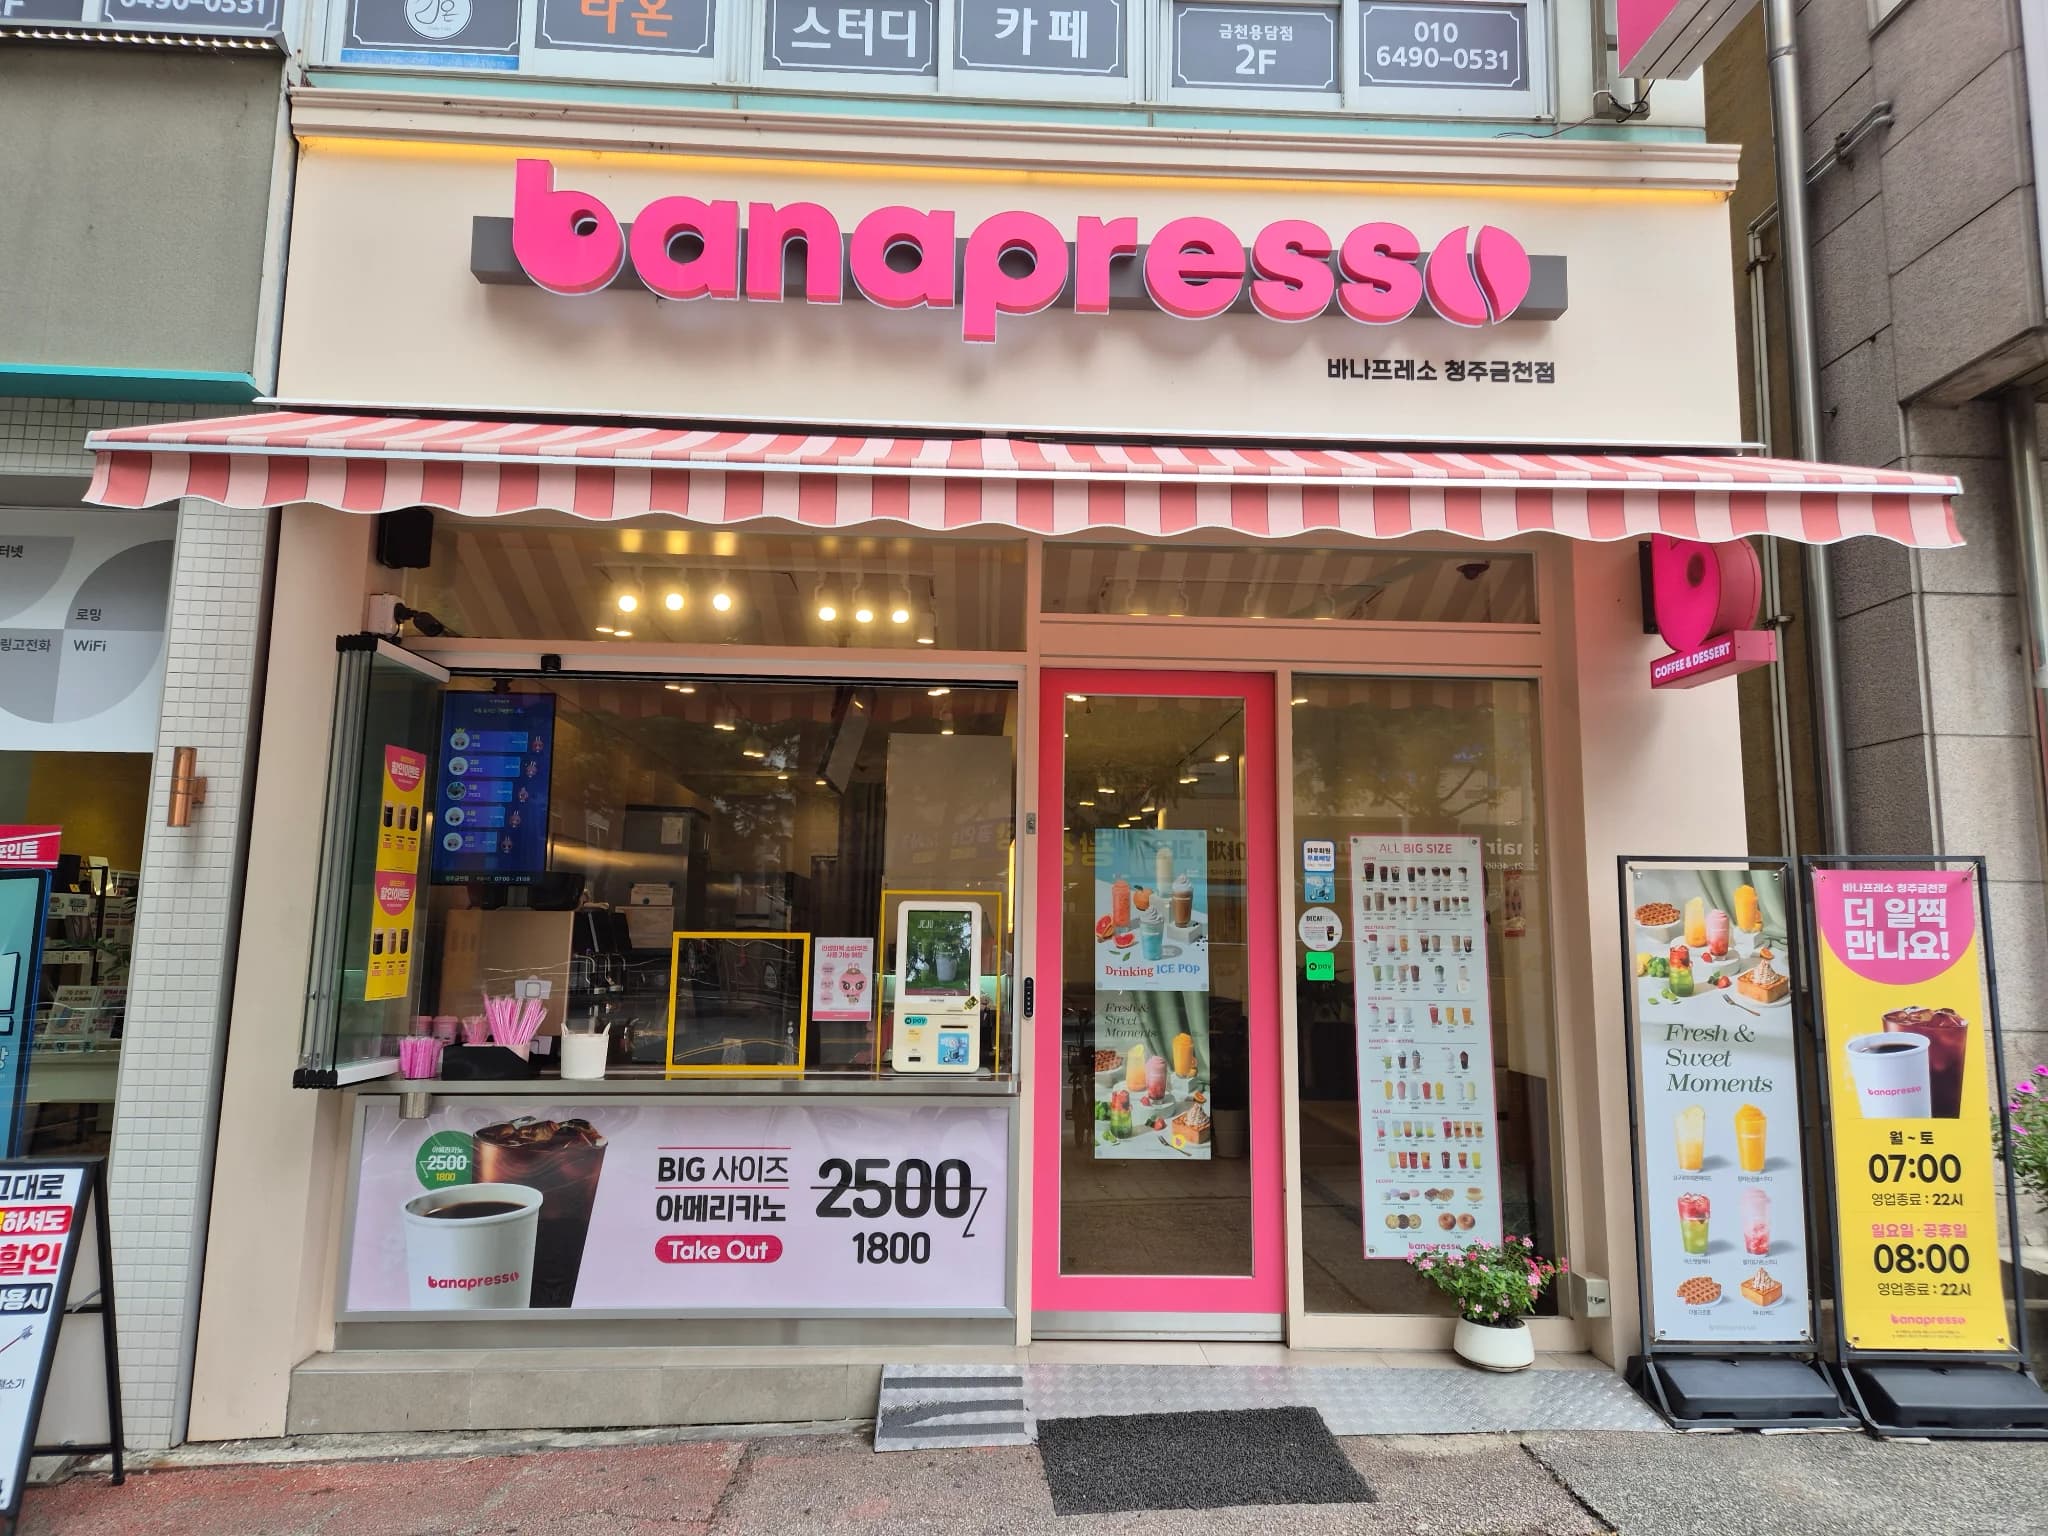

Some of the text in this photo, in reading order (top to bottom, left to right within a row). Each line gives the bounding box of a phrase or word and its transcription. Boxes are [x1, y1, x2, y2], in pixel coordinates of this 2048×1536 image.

[791, 7, 916, 58] 스터디
[994, 8, 1088, 59] 카페
[1218, 24, 1293, 41] 금천용담점
[1414, 21, 1458, 43] 010
[1235, 44, 1277, 75] 2F
[1375, 46, 1508, 71] 6490-0531
[511, 158, 1532, 343] banapresso
[1327, 358, 1555, 384] 바나프레소 청주금천점
[75, 608, 102, 622] 로밍
[73, 639, 107, 652] WiFi
[1655, 642, 1731, 678] COFFEE & DESSERT
[1379, 843, 1453, 854] ALL BIG SIZE
[1842, 882, 1947, 893] 바나프레소 청주금천점
[1844, 898, 1947, 928] 더 일찍
[1845, 931, 1950, 960] 만나요!
[1105, 963, 1201, 978] Drinking ICE POP
[1105, 1002, 1136, 1013] Fresh
[1105, 1027, 1158, 1038] Moments
[1664, 1023, 1756, 1043] Fresh &
[1665, 1048, 1732, 1067] Sweet
[1666, 1073, 1773, 1093] Moments
[1867, 1086, 1921, 1096] banapresso
[1889, 1131, 1903, 1145] 월
[1919, 1131, 1935, 1145] 토
[426, 1154, 467, 1171] 2500
[658, 1156, 789, 1183] BIG 사이즈
[1868, 1153, 1962, 1183] 07:00
[815, 1158, 972, 1218] 2500
[656, 1194, 787, 1223] 아메리카노
[1871, 1193, 1922, 1206] 영업종료
[1932, 1193, 1963, 1206] 22시
[0, 1210, 67, 1233] 하셔도
[1872, 1224, 1968, 1239] 일요일 공휴일
[667, 1240, 769, 1260] Take Out
[852, 1231, 931, 1264] 1800
[1873, 1243, 1970, 1274] 08:00
[427, 1271, 520, 1291] banapresso
[1877, 1283, 1930, 1296] 영업종료
[1940, 1283, 1971, 1296] 22시
[1890, 1314, 1966, 1326] banapresso
